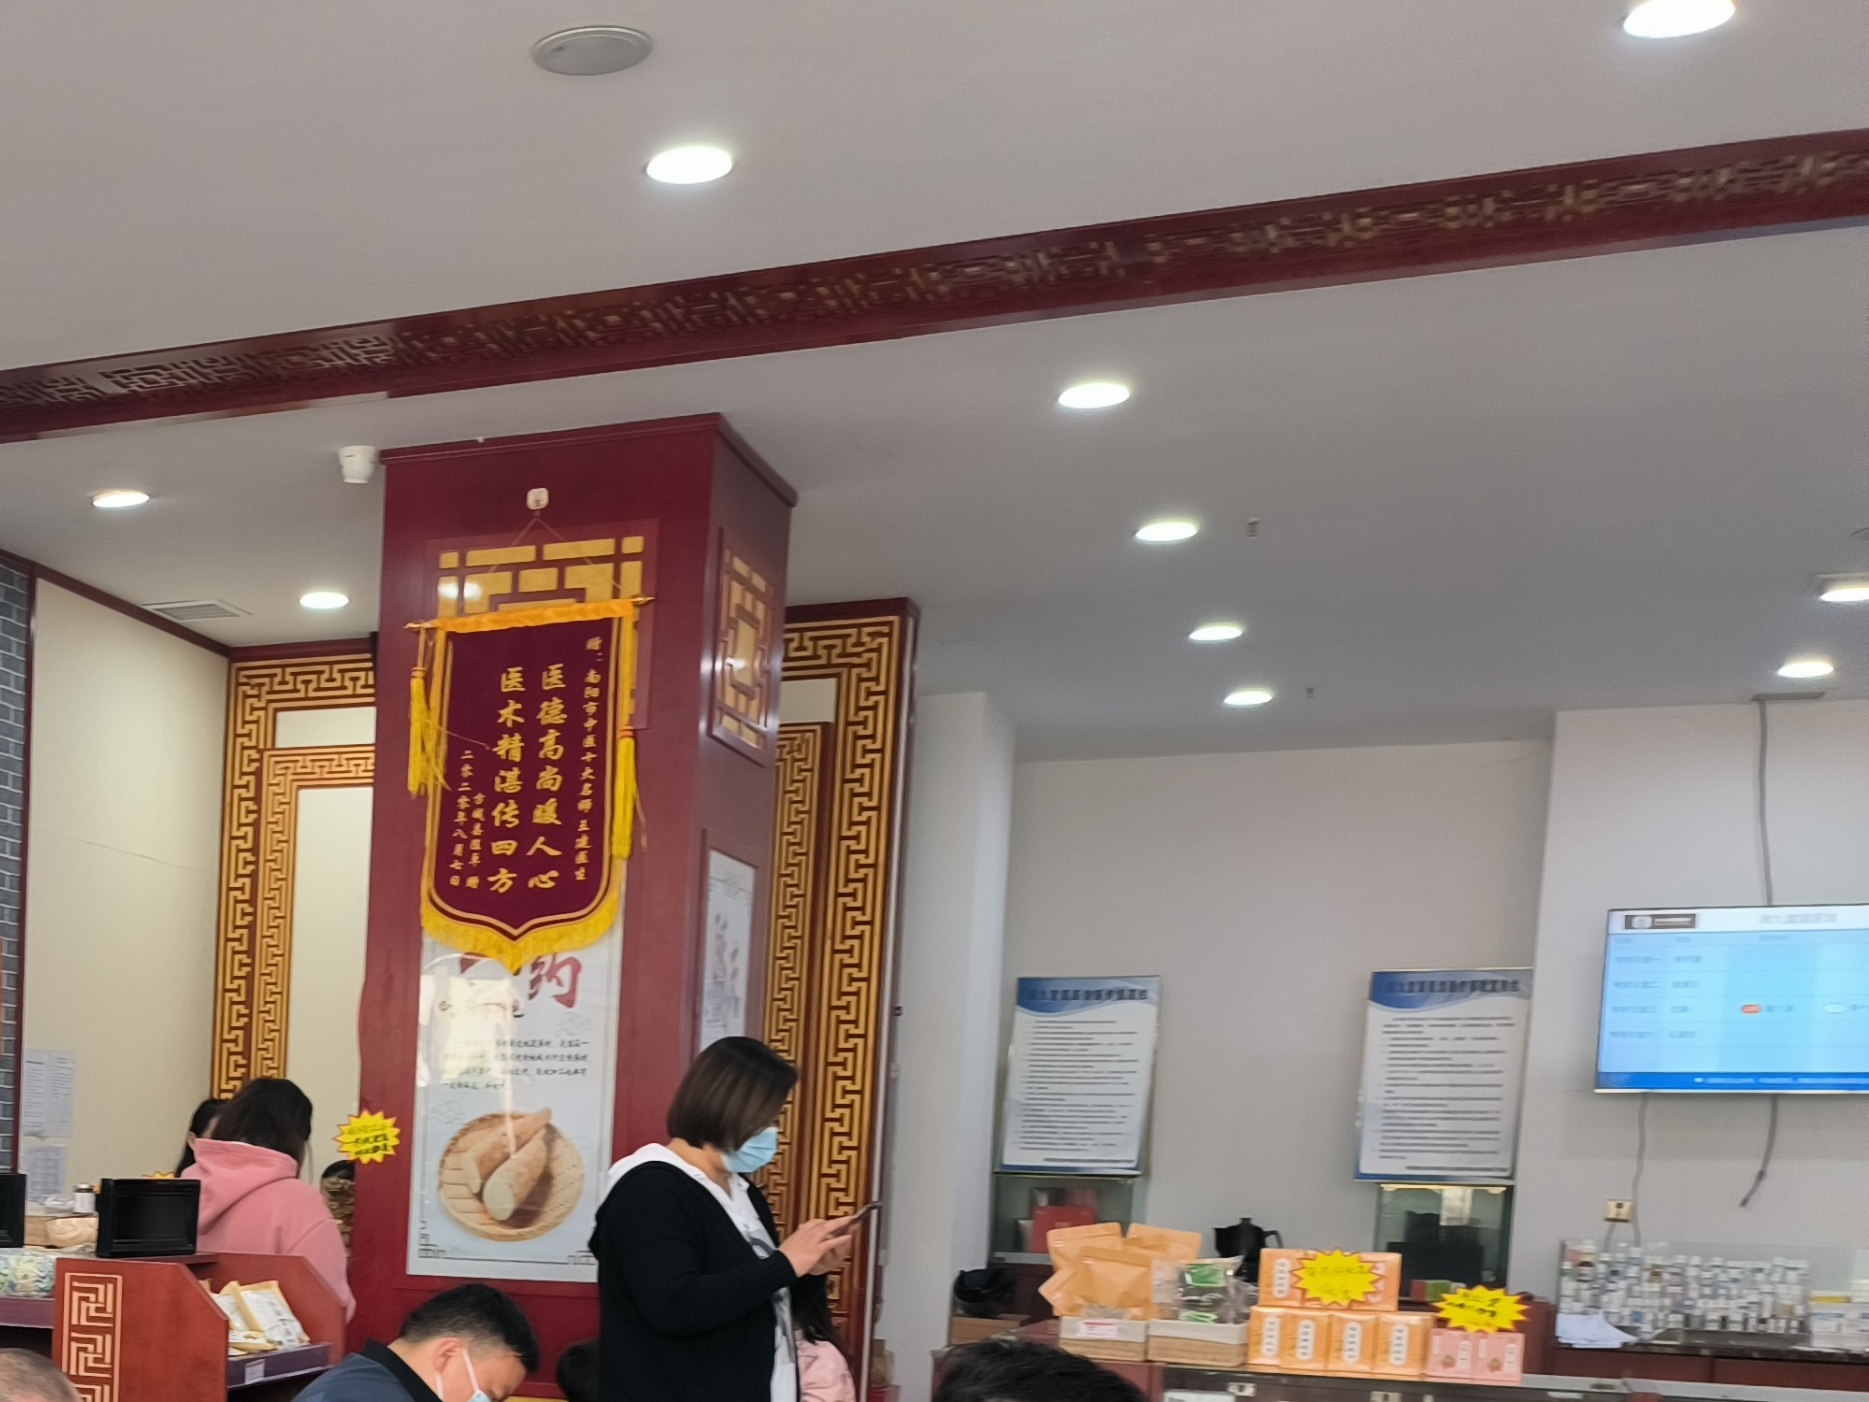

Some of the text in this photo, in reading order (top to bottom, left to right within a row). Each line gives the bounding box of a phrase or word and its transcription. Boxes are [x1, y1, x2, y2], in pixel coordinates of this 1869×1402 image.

[486, 666, 526, 893] 医术精湛传四方
[526, 663, 567, 888] 医德高尚暖人心
